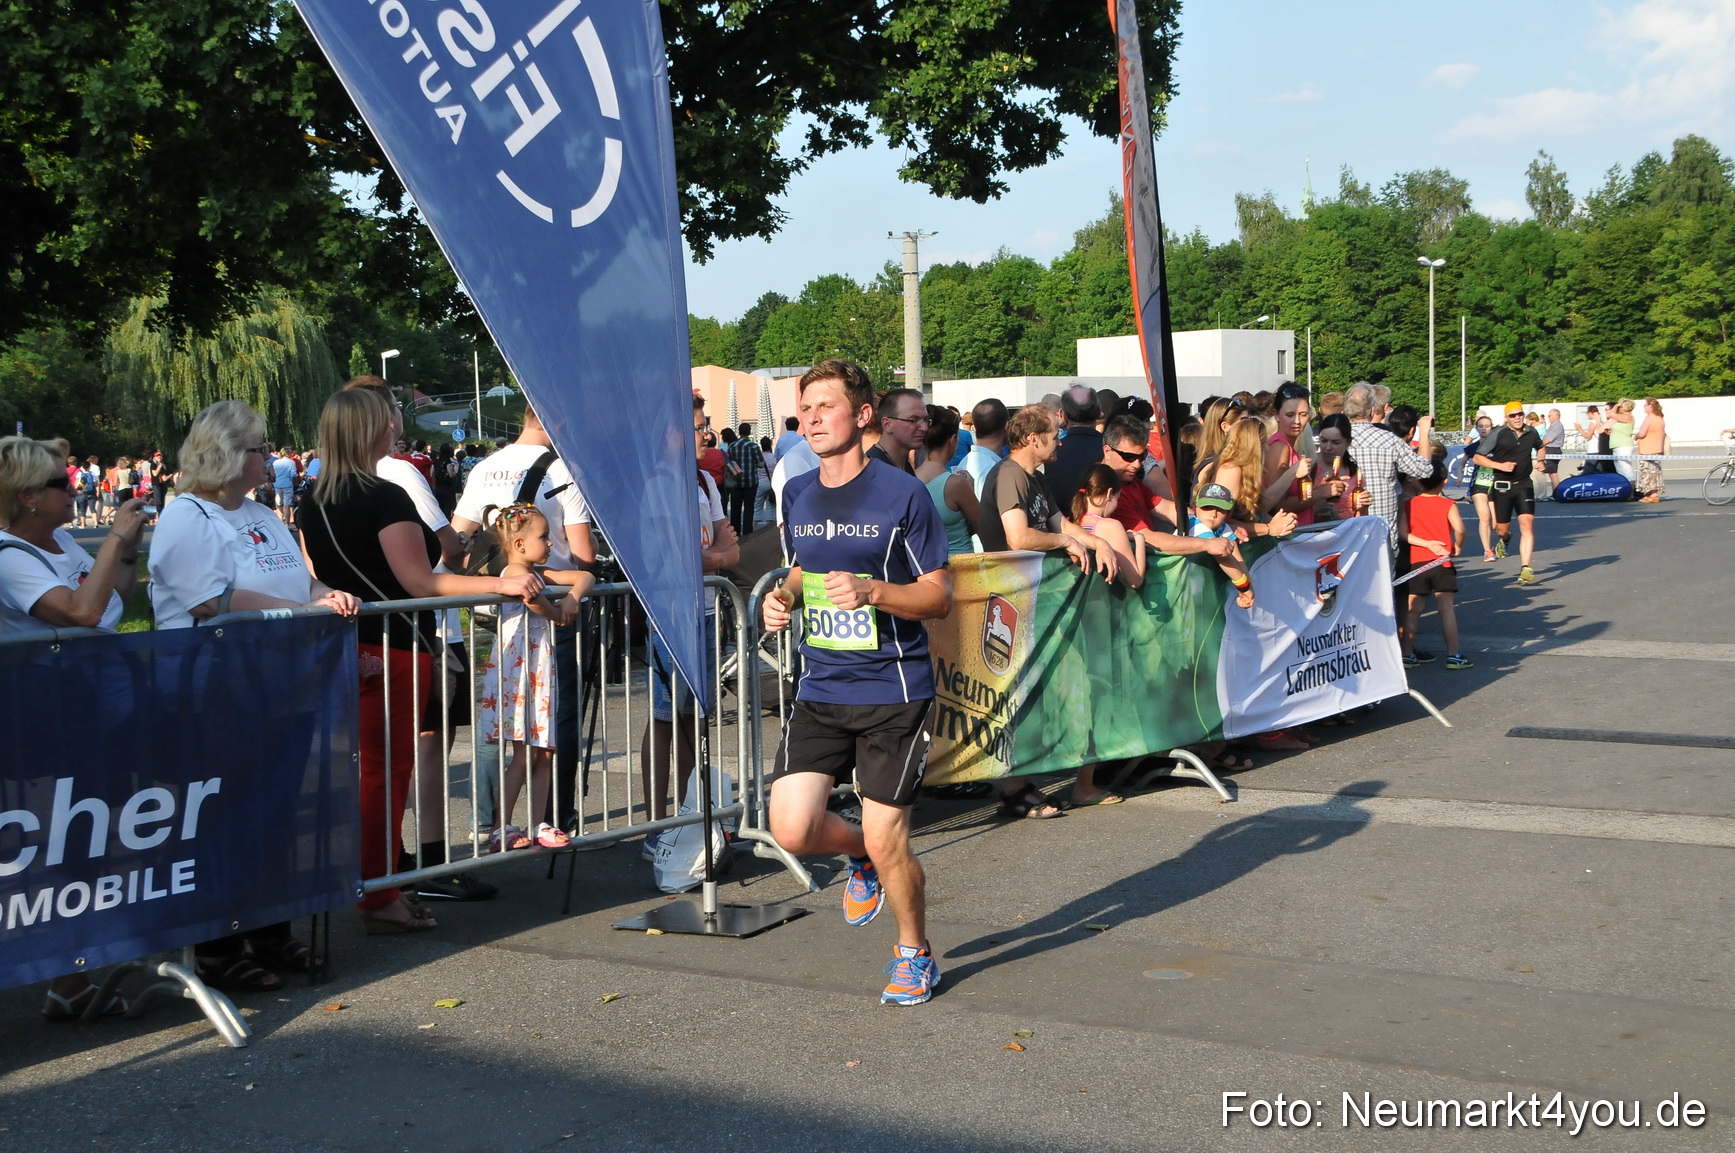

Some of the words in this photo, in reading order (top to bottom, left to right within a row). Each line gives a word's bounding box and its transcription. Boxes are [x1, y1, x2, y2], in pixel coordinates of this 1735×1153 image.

[1574, 487, 1622, 498] Fischer
[794, 524, 824, 538] EURO
[837, 523, 879, 538] POLES
[256, 554, 299, 568] POLGER
[808, 608, 872, 639] 5088
[1286, 644, 1372, 696] Lammsbräu
[0, 858, 196, 930] MOBILE
